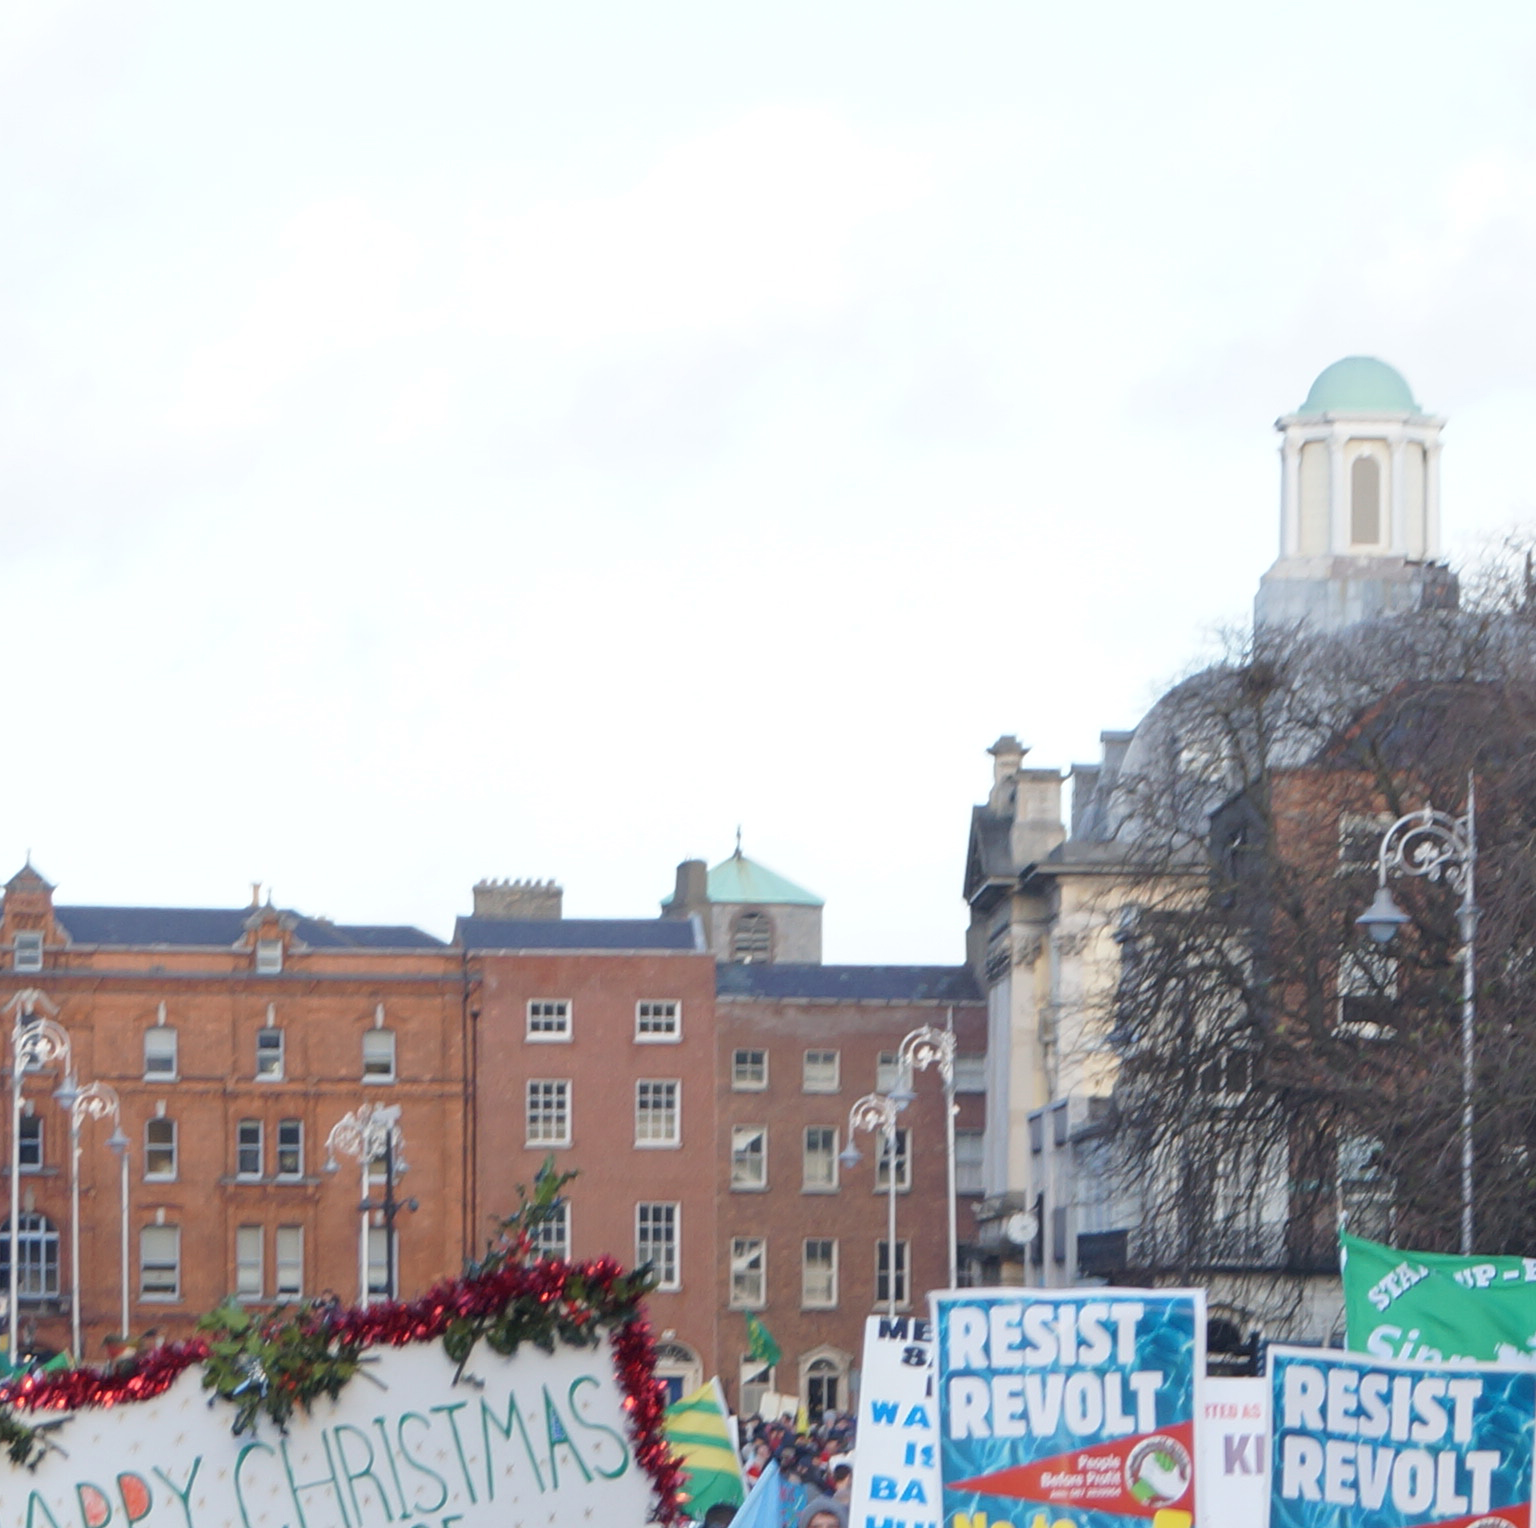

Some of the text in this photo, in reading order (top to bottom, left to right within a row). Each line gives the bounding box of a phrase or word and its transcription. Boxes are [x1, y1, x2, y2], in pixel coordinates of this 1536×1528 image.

[1367, 1260, 1431, 1313] STA
[947, 1301, 1145, 1371] RESIST
[948, 1370, 1164, 1441] REVOLT
[1282, 1364, 1484, 1444] RESIST
[1040, 1470, 1122, 1488] Before Profit
[1077, 1452, 1122, 1472] People
[1281, 1433, 1502, 1516] REVOLT
